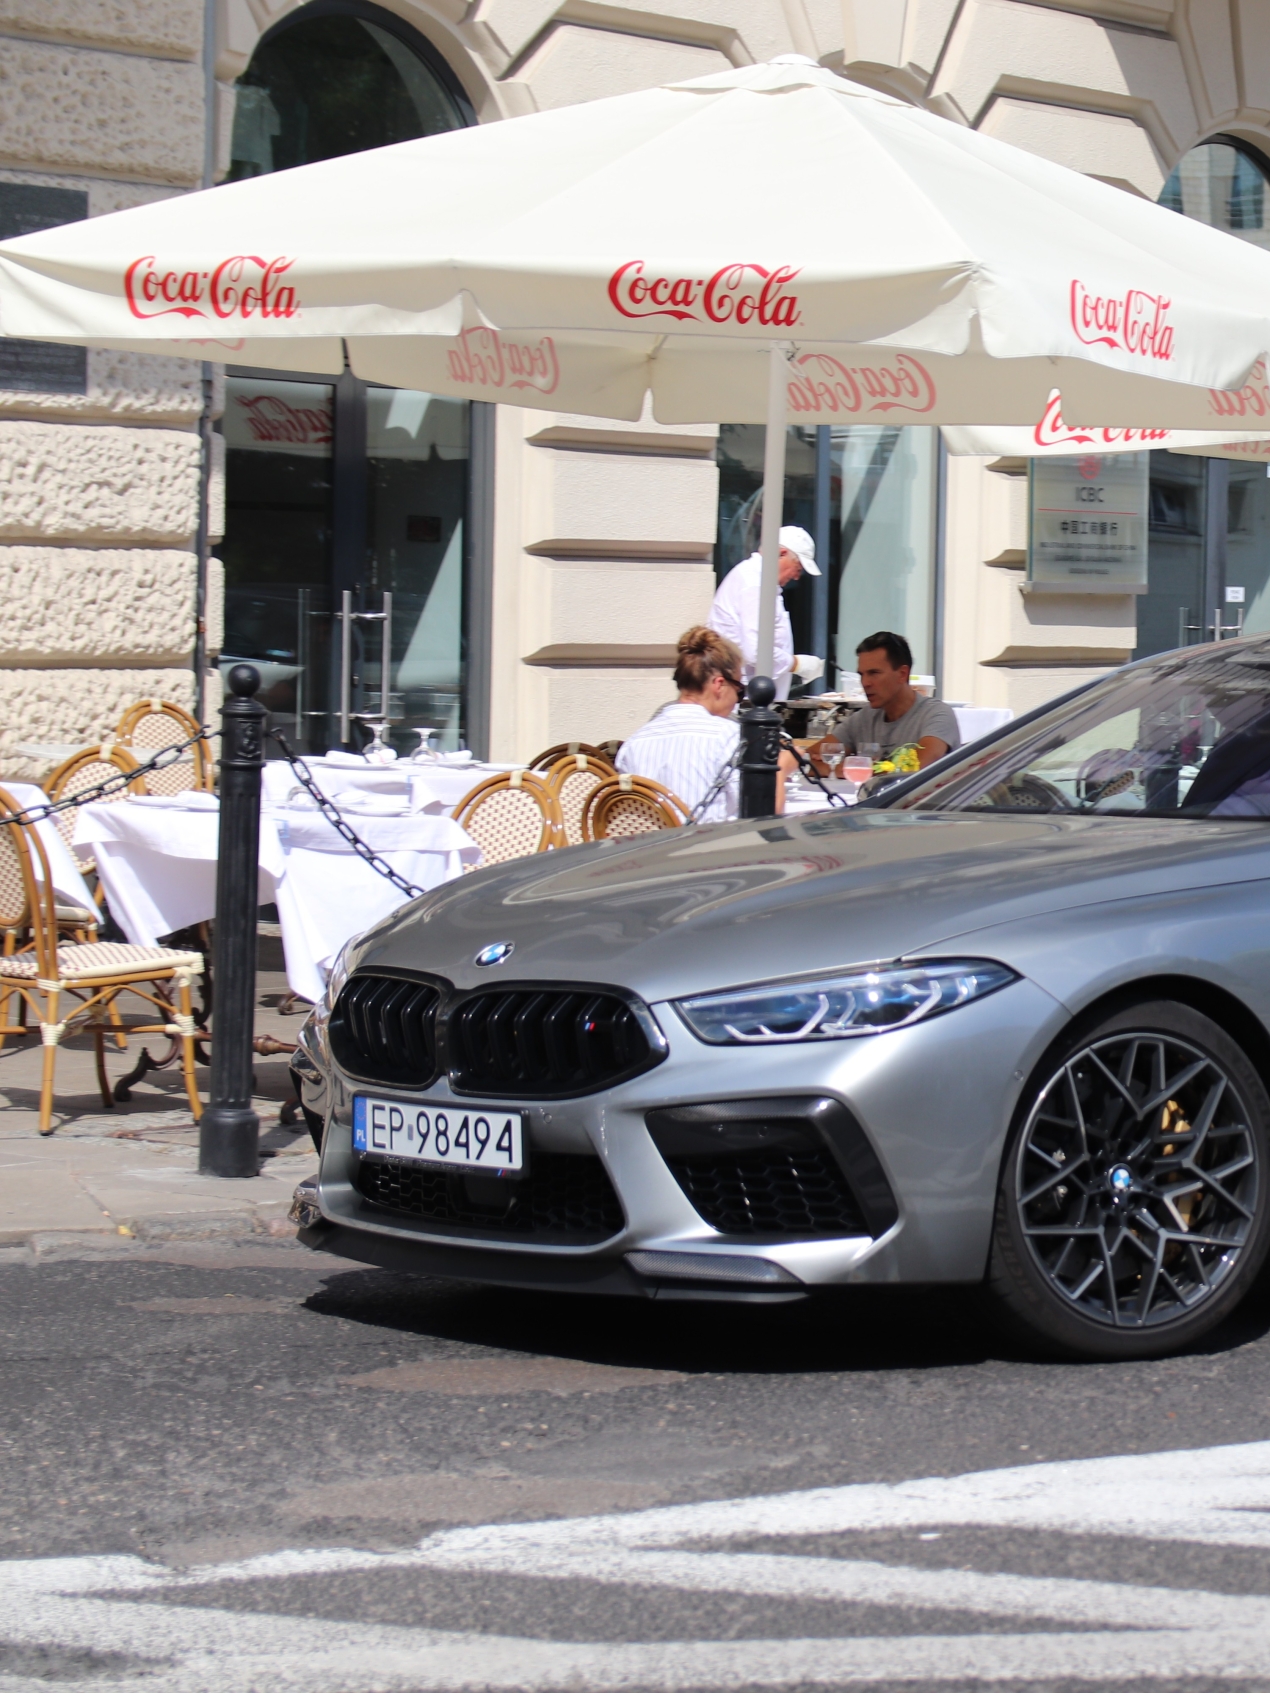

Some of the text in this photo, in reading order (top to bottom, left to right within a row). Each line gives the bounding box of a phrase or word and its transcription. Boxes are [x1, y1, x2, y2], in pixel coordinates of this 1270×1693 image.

[124, 255, 302, 320] Coca-Cola
[608, 260, 806, 326] Coca-Cola
[1070, 279, 1176, 361] Coca-Cola
[1075, 486, 1105, 503] ICBC
[356, 1129, 366, 1142] PL
[372, 1104, 513, 1164] EP 98494
